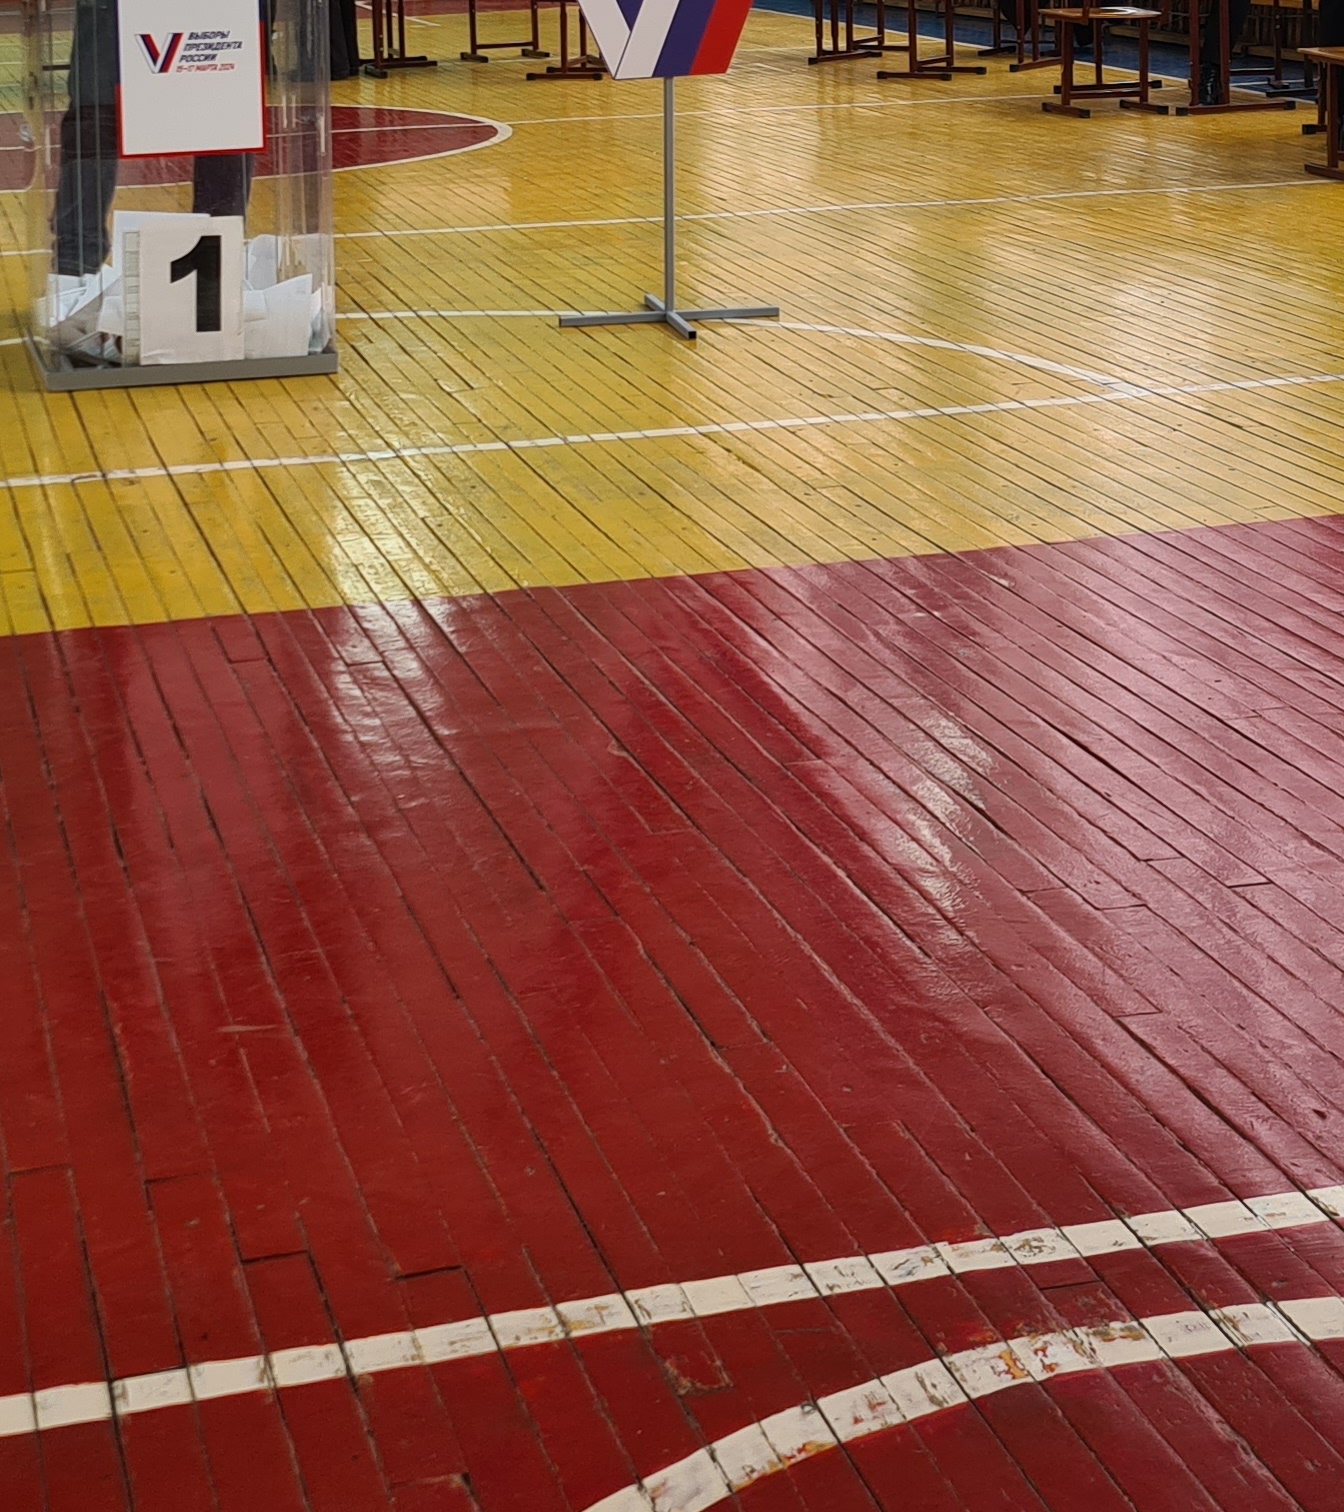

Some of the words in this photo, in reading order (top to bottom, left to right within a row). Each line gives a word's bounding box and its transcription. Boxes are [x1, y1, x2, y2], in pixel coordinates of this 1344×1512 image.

[188, 30, 230, 40] ВЫБОРЫ
[183, 41, 243, 52] ПРЕЗИДЕНТА
[179, 53, 218, 63] РОССИИ
[170, 235, 221, 332] 1
